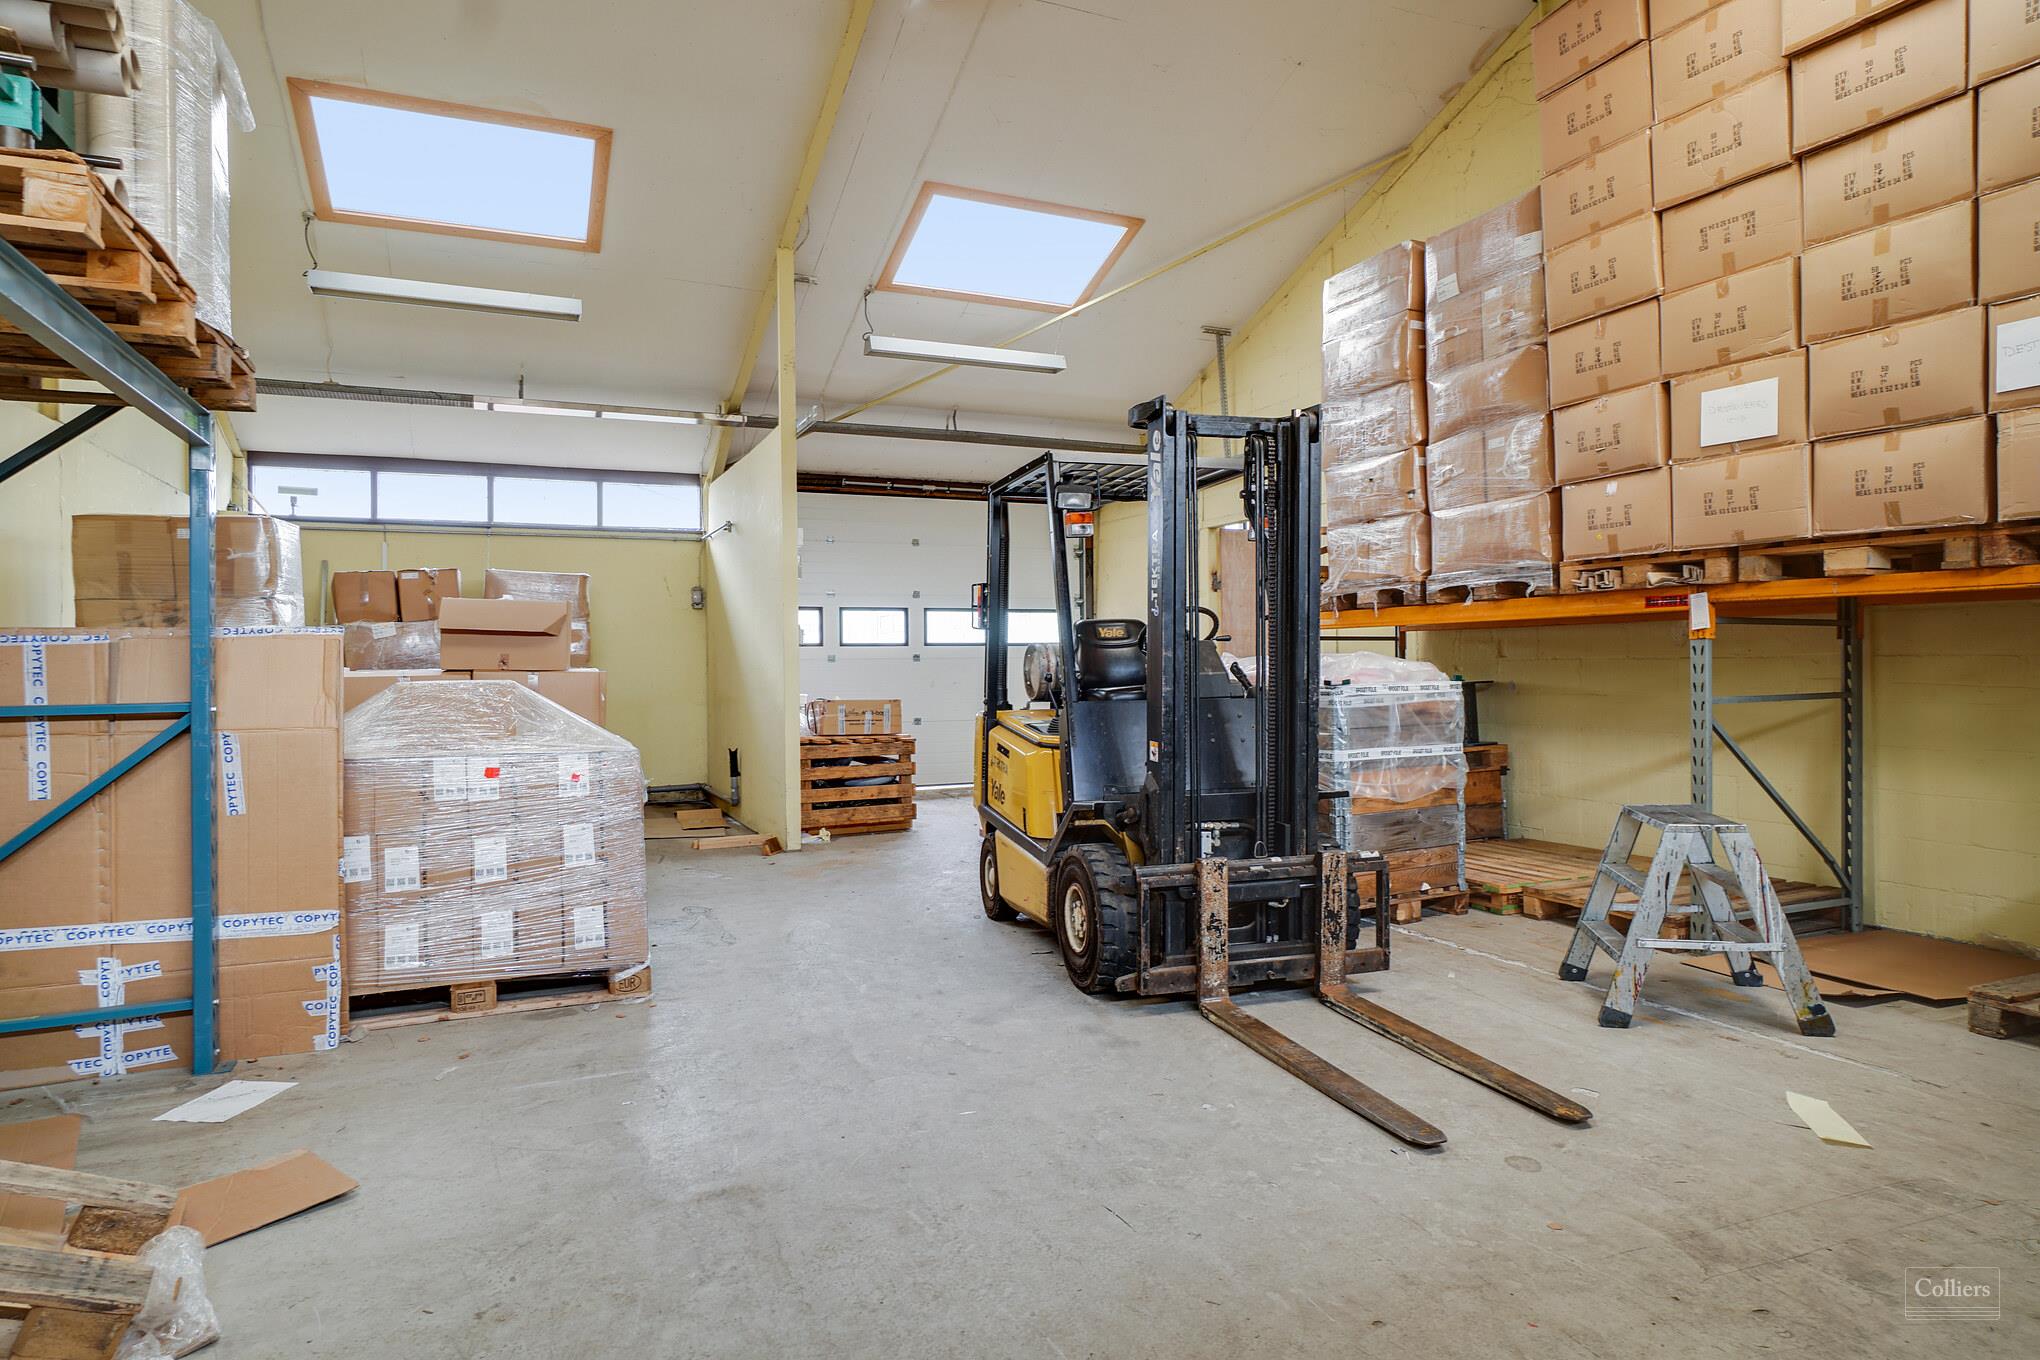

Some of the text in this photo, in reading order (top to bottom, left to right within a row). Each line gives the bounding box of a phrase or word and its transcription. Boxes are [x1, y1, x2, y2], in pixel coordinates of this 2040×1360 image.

[1150, 429, 1161, 502] Yale
[1098, 628, 1125, 637] Yale
[987, 779, 1005, 805] Yale
[66, 927, 136, 941] COPYTEC
[222, 916, 285, 928] COPYTEC
[328, 995, 337, 1047] COPYTEC
